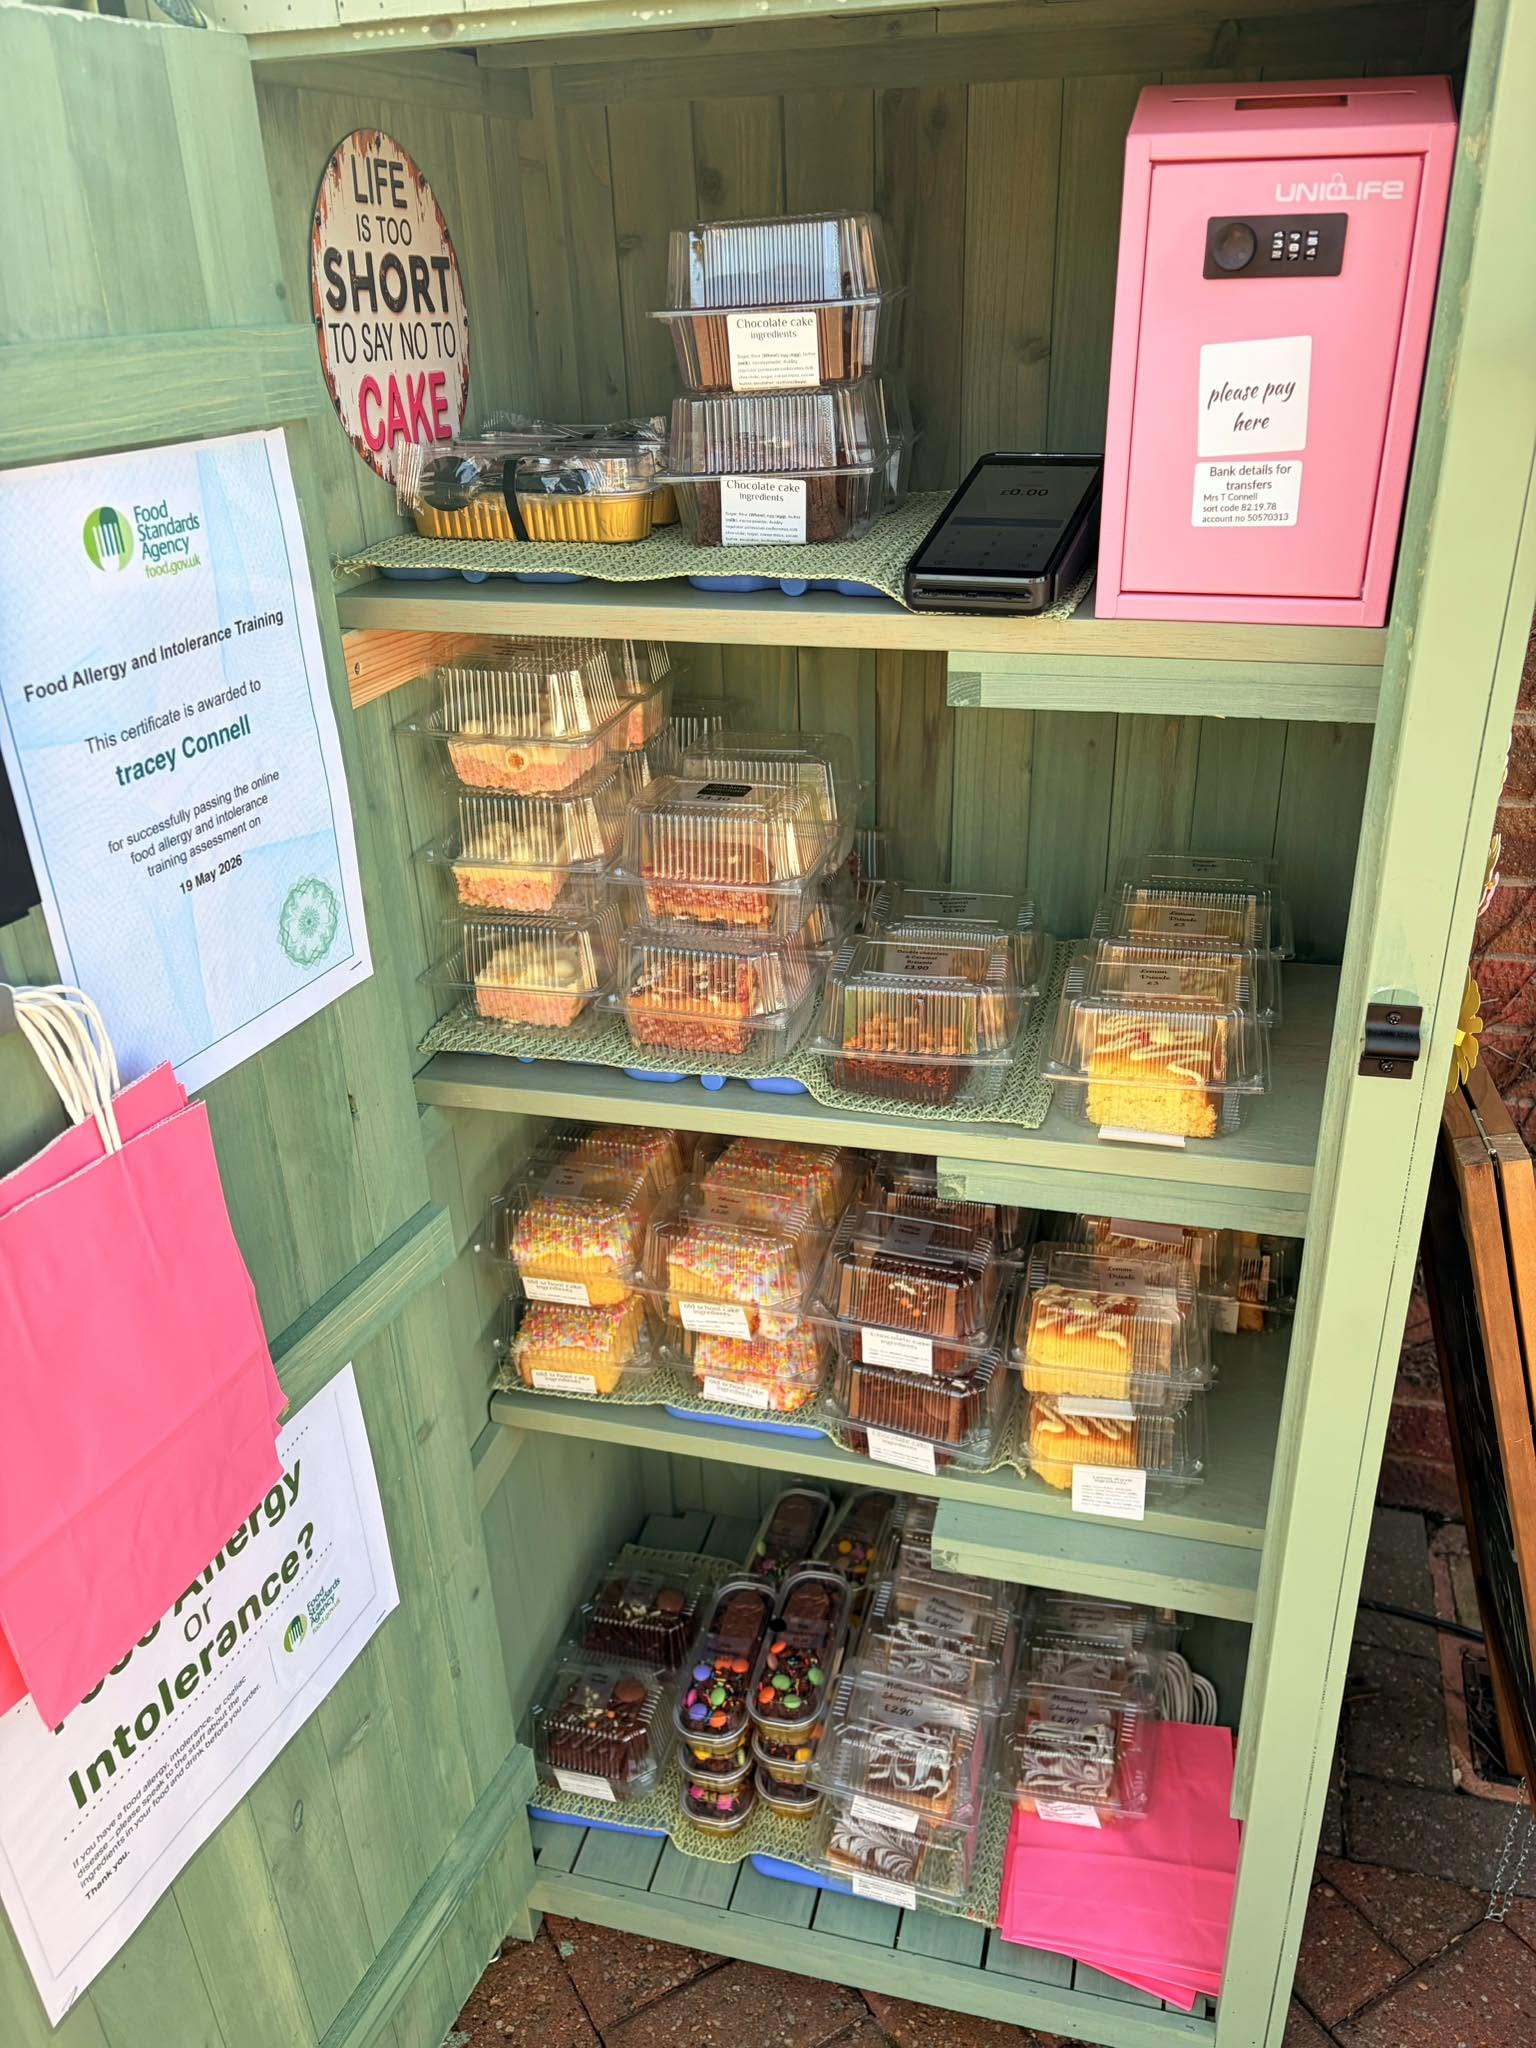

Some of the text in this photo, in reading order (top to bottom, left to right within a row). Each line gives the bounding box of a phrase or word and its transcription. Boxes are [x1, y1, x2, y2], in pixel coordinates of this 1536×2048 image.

[350, 153, 408, 209] LIFE
[356, 213, 413, 246] IS TOO
[323, 246, 450, 314] SHORT
[736, 316, 814, 329] Chocolate cake
[328, 321, 457, 364] TO SAY NO TO
[357, 370, 452, 451] CAKE
[1207, 381, 1297, 410] please pay
[1233, 412, 1270, 432] here
[726, 480, 800, 492] Chocolate cake
[1209, 464, 1292, 477] Bank details for
[1226, 480, 1272, 491] transfers
[133, 499, 169, 523] Food
[1203, 492, 1258, 502] Mrs T Connell
[1220, 504, 1239, 512] code
[1241, 502, 1277, 511] 82.19.78
[136, 512, 201, 542] Standards
[1202, 515, 1233, 523] account
[1235, 515, 1245, 523] no
[142, 536, 189, 562] Agency
[144, 553, 202, 579] food.gov.uk
[23, 611, 284, 703] Food Allergy and Intolerance Training
[84, 679, 262, 754] This certificate is awarded to
[115, 713, 251, 786] tracey Connell
[108, 771, 280, 854] for successfully passing the online
[130, 794, 269, 864] food allergy and intolerance
[147, 816, 262, 877] training assessment on
[179, 854, 243, 894] 19 May 2026
[306, 1586, 324, 1611] Food
[308, 1577, 341, 1616] Standards
[310, 1593, 335, 1627] Agency
[184, 1597, 213, 1642] or
[68, 1521, 314, 1810] Intolerance?
[884, 1703, 914, 1717] £2.90
[72, 1675, 247, 1869] If you have a food allergy, intolerance, or coeliac
[77, 1842, 109, 1879] disease
[115, 1806, 141, 1837] please
[142, 1780, 165, 1806] speak
[165, 1770, 174, 1780] to
[174, 1752, 188, 1769] the
[188, 1735, 207, 1755] staff
[207, 1710, 228, 1735] about
[228, 1696, 240, 1711] the
[80, 1683, 261, 1889] ingredients in your food and drink before you order.
[85, 1850, 130, 1901] Thank you.
